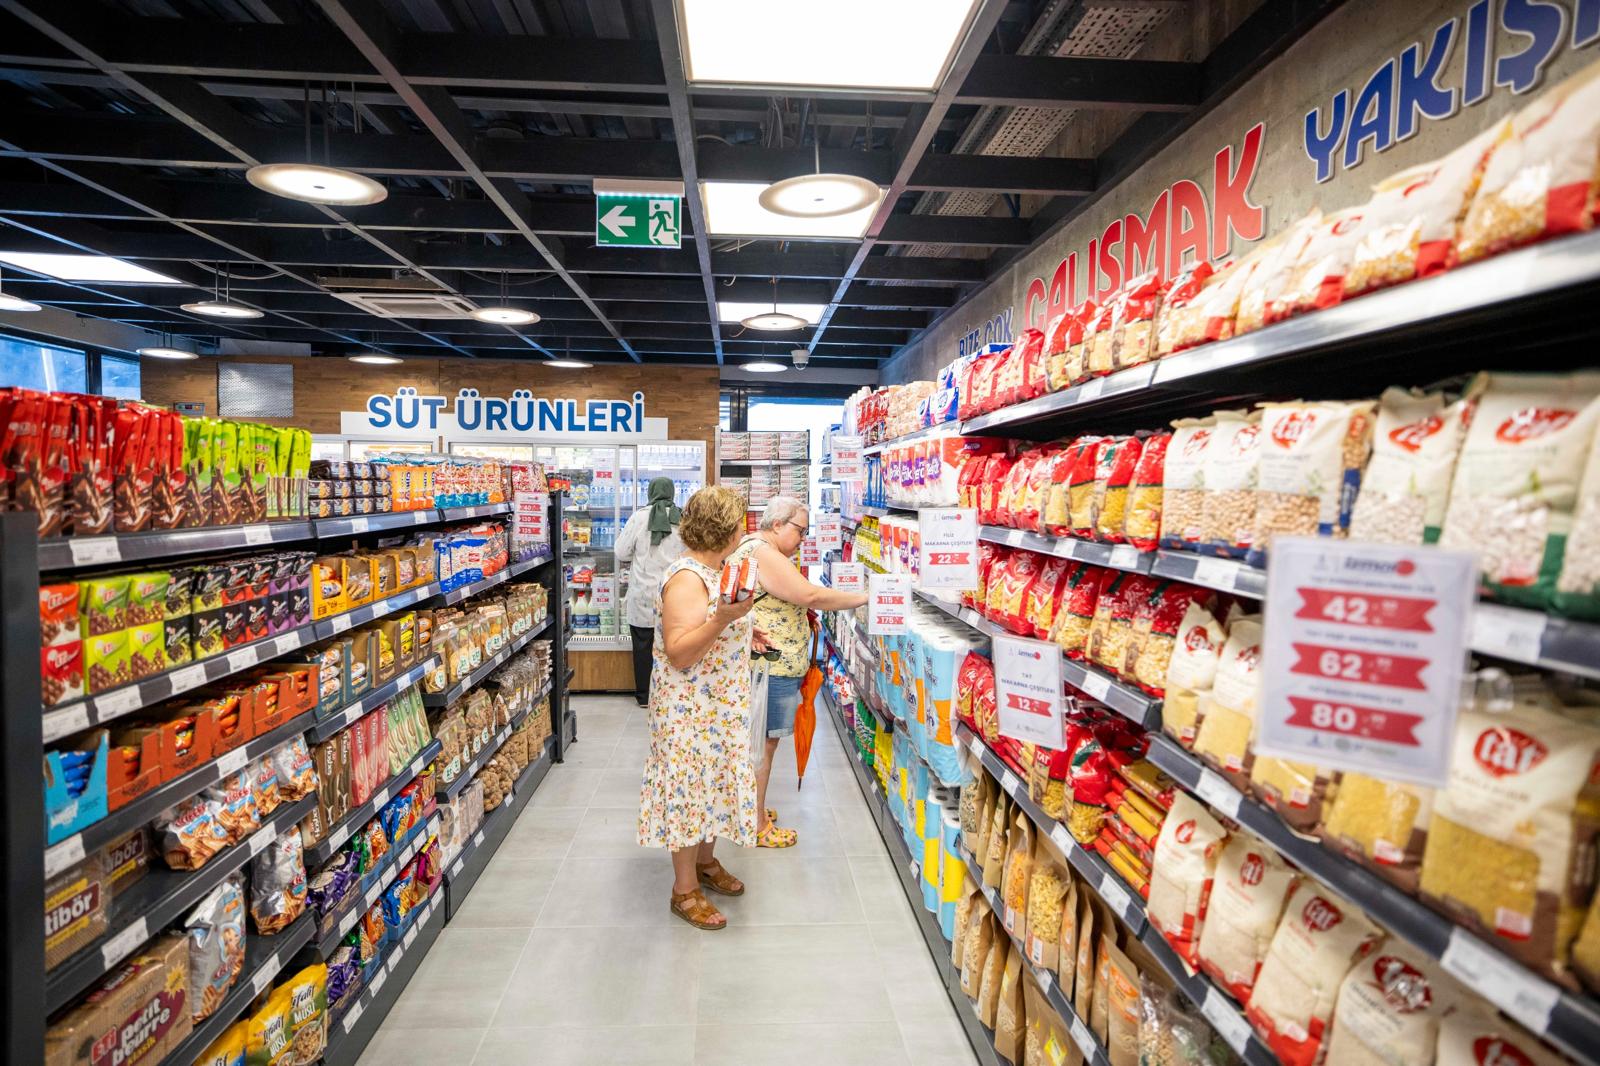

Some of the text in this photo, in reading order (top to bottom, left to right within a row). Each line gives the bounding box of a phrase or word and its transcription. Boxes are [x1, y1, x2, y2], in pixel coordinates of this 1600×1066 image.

[368, 388, 643, 433] SÜT ÜRÜNLERİ
[937, 554, 952, 564] 22
[1322, 595, 1369, 624] 42
[1319, 650, 1363, 680] 62
[1311, 702, 1357, 731] 80
